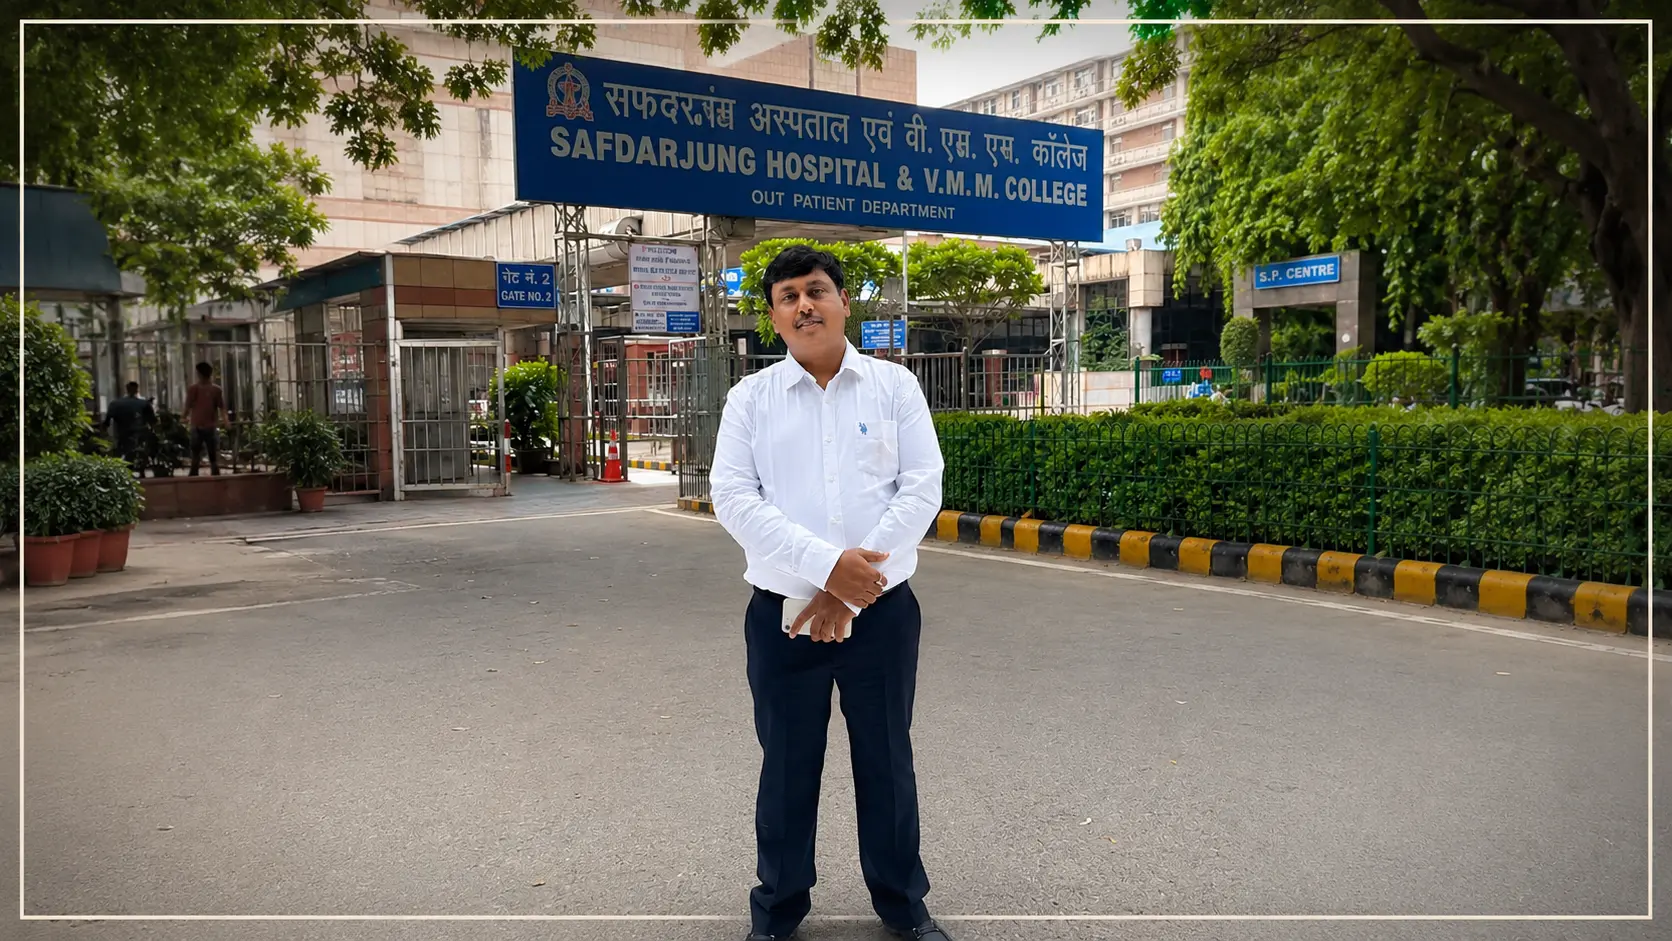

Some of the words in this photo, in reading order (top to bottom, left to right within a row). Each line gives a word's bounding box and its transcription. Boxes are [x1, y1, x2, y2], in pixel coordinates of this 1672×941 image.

[750, 103, 849, 144] अस्पताल
[861, 111, 893, 153] एवं
[904, 114, 932, 153] वी.
[1031, 132, 1088, 171] कॉलेज
[551, 126, 756, 175] SAFDARJUNG
[767, 150, 886, 188] HOSPITAL
[897, 165, 913, 191] &
[1005, 176, 1087, 207] COLLEGE
[751, 190, 784, 206] OUT
[793, 194, 855, 211] PATIENT
[862, 200, 955, 219] DEPARTMENT
[542, 273, 551, 285] 2
[1259, 270, 1283, 282] S.P.
[1286, 264, 1334, 279] CENTRE
[501, 290, 526, 301] GATE
